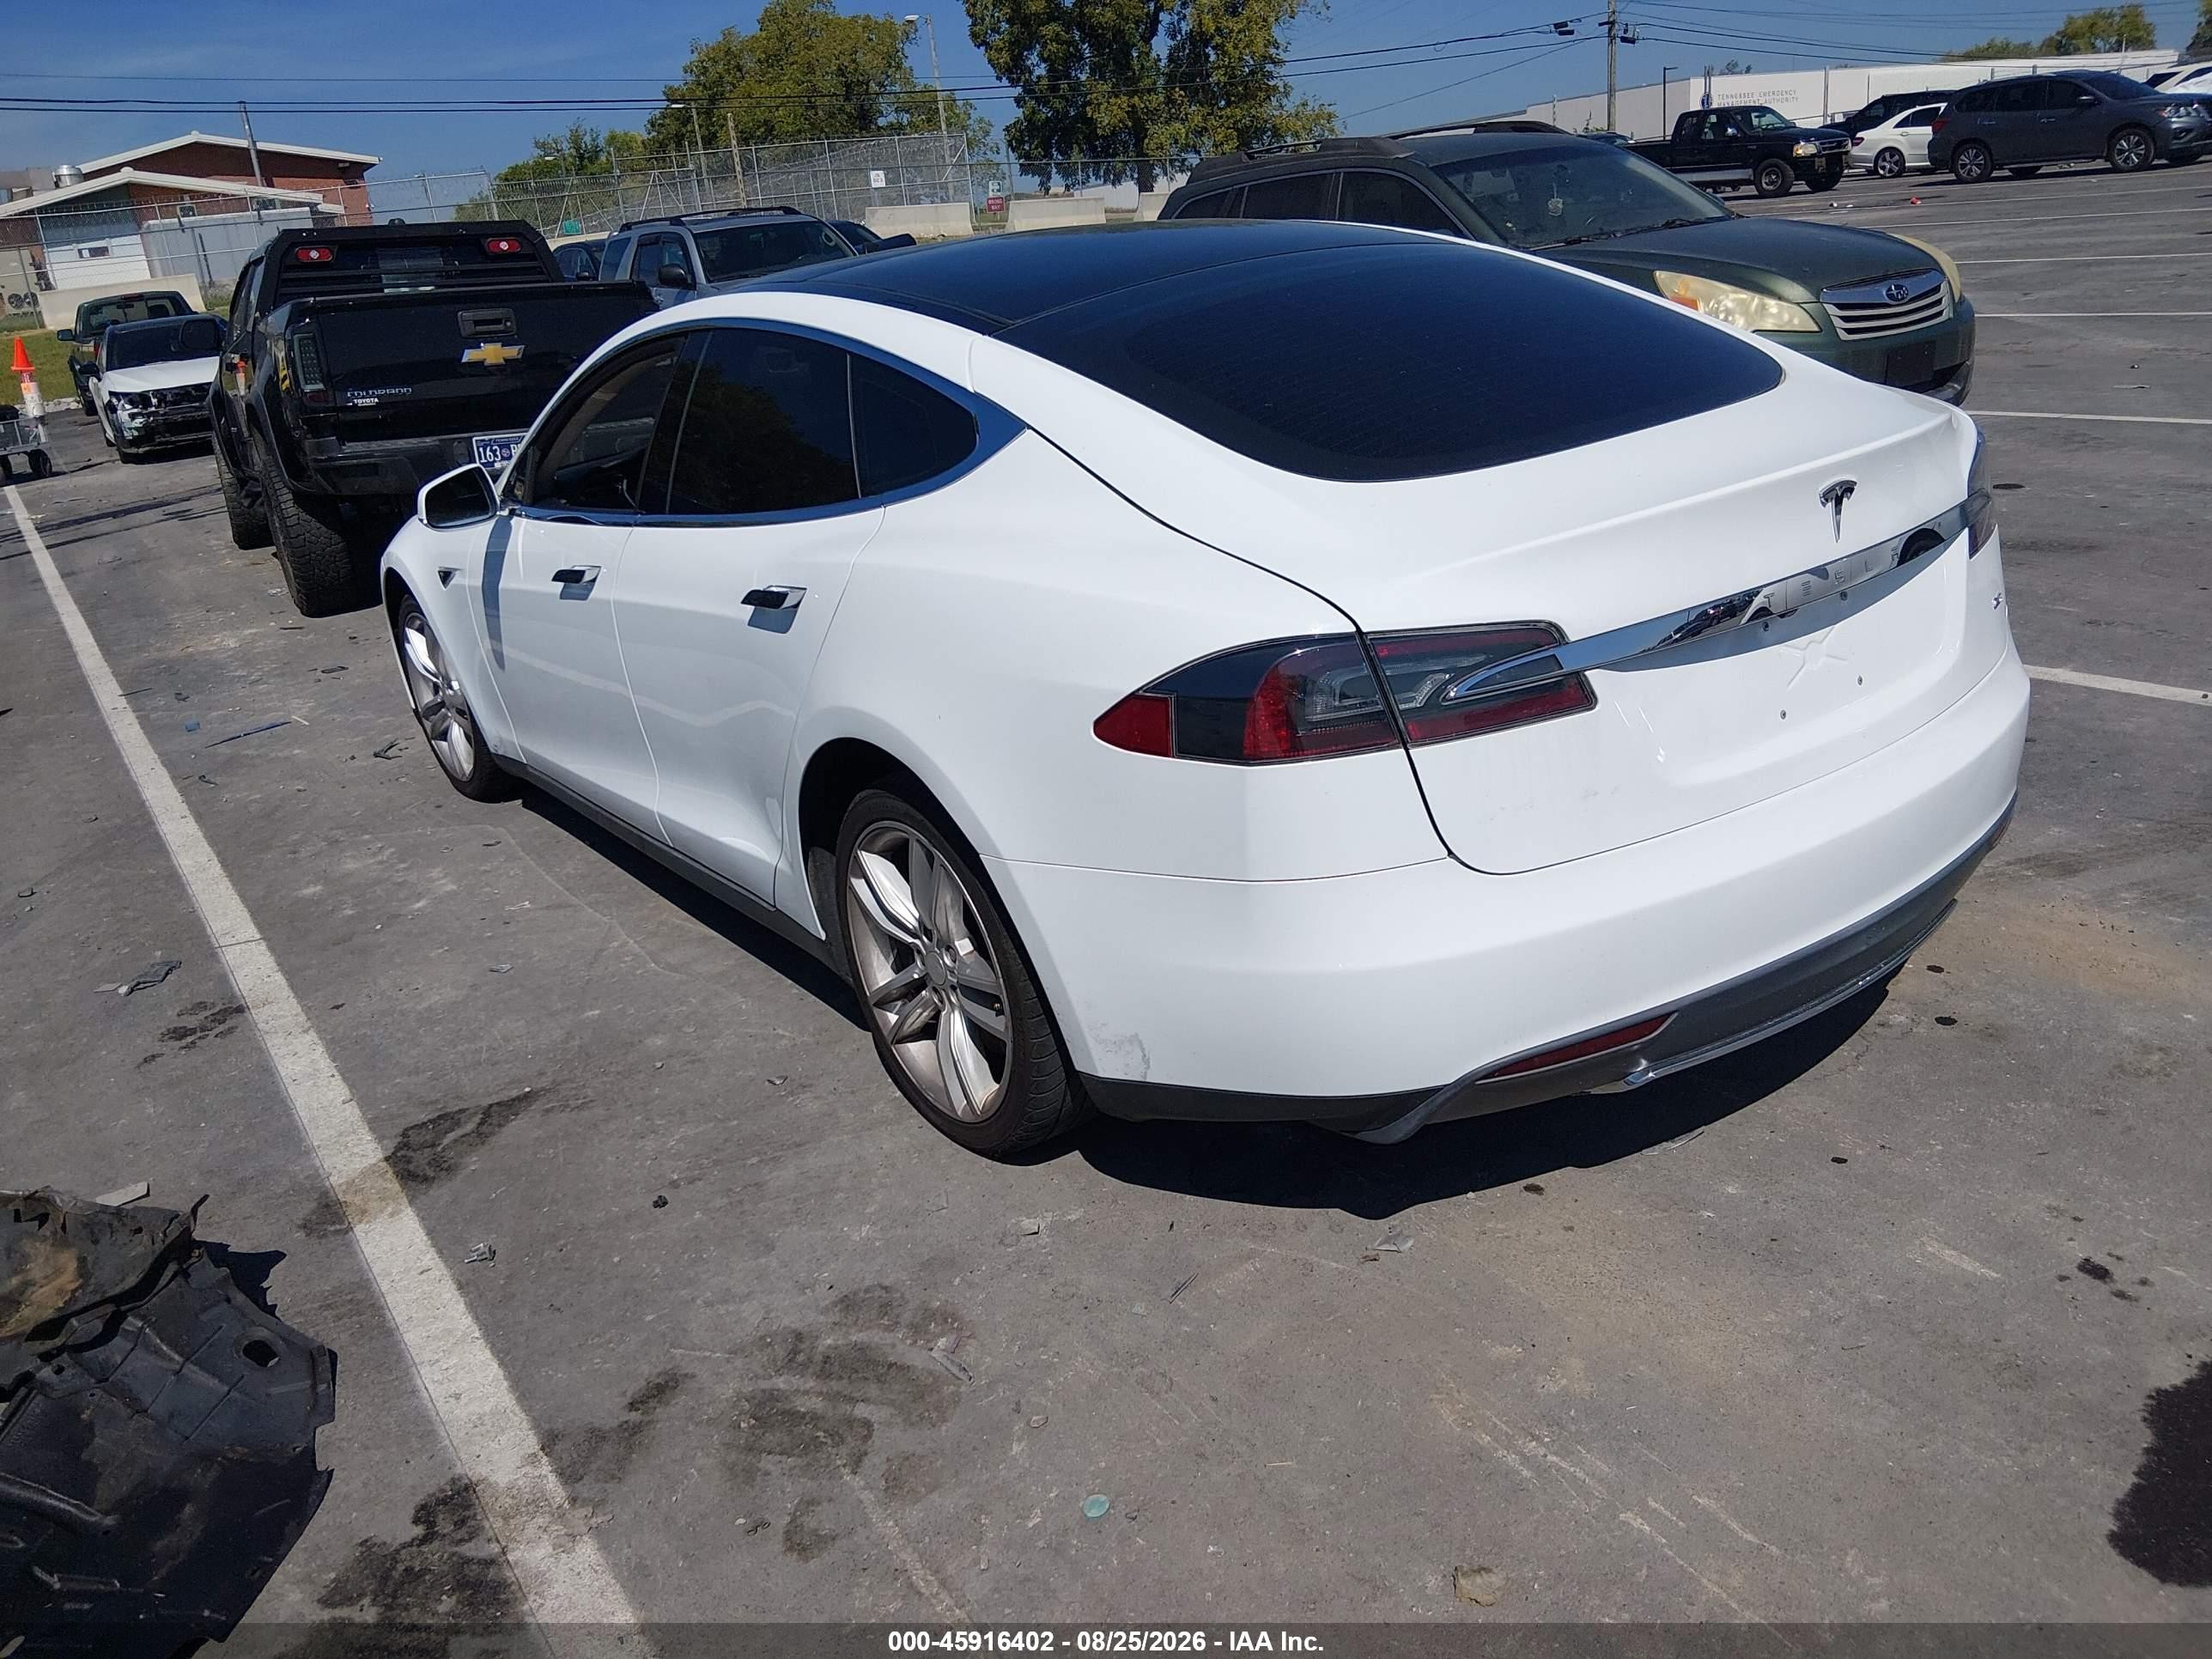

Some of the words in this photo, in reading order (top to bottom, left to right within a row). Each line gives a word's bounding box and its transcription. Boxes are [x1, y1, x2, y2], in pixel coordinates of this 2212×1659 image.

[1717, 92, 1756, 100] TENNESSEE
[1759, 89, 1796, 98] EMERGENCY
[1764, 96, 1799, 105] AUTHORITY
[479, 445, 501, 463] 163
